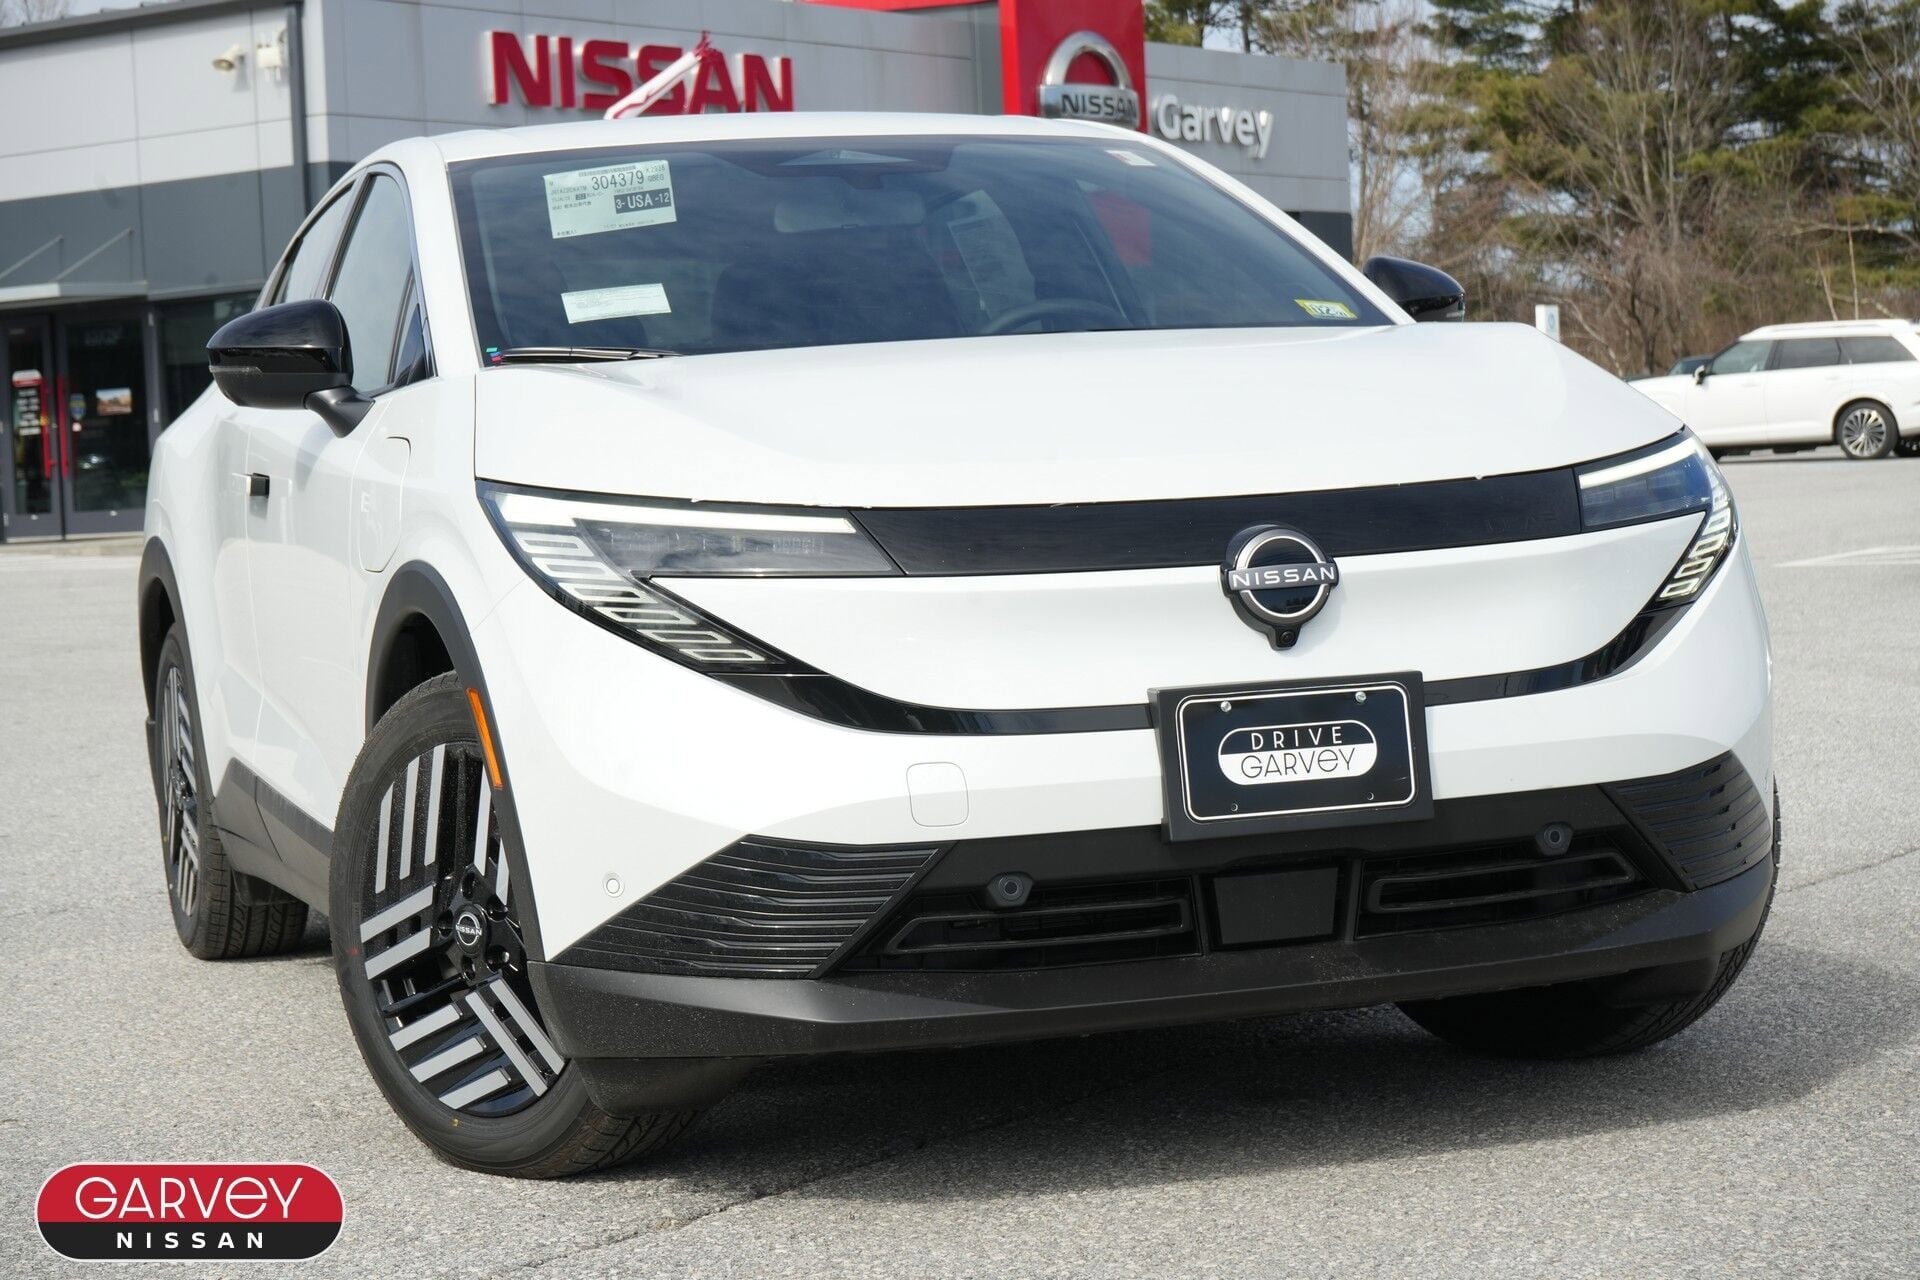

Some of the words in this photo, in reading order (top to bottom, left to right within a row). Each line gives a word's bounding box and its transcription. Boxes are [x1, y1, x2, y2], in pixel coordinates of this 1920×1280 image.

[489, 31, 795, 114] NISSAN
[1060, 93, 1138, 119] NISSAN
[1154, 94, 1274, 158] Garvey
[591, 170, 645, 191] 304379
[627, 193, 653, 209] USA
[1233, 566, 1335, 587] NISSAN
[1251, 726, 1343, 750] DRIVE
[1240, 747, 1356, 779] GARVEY
